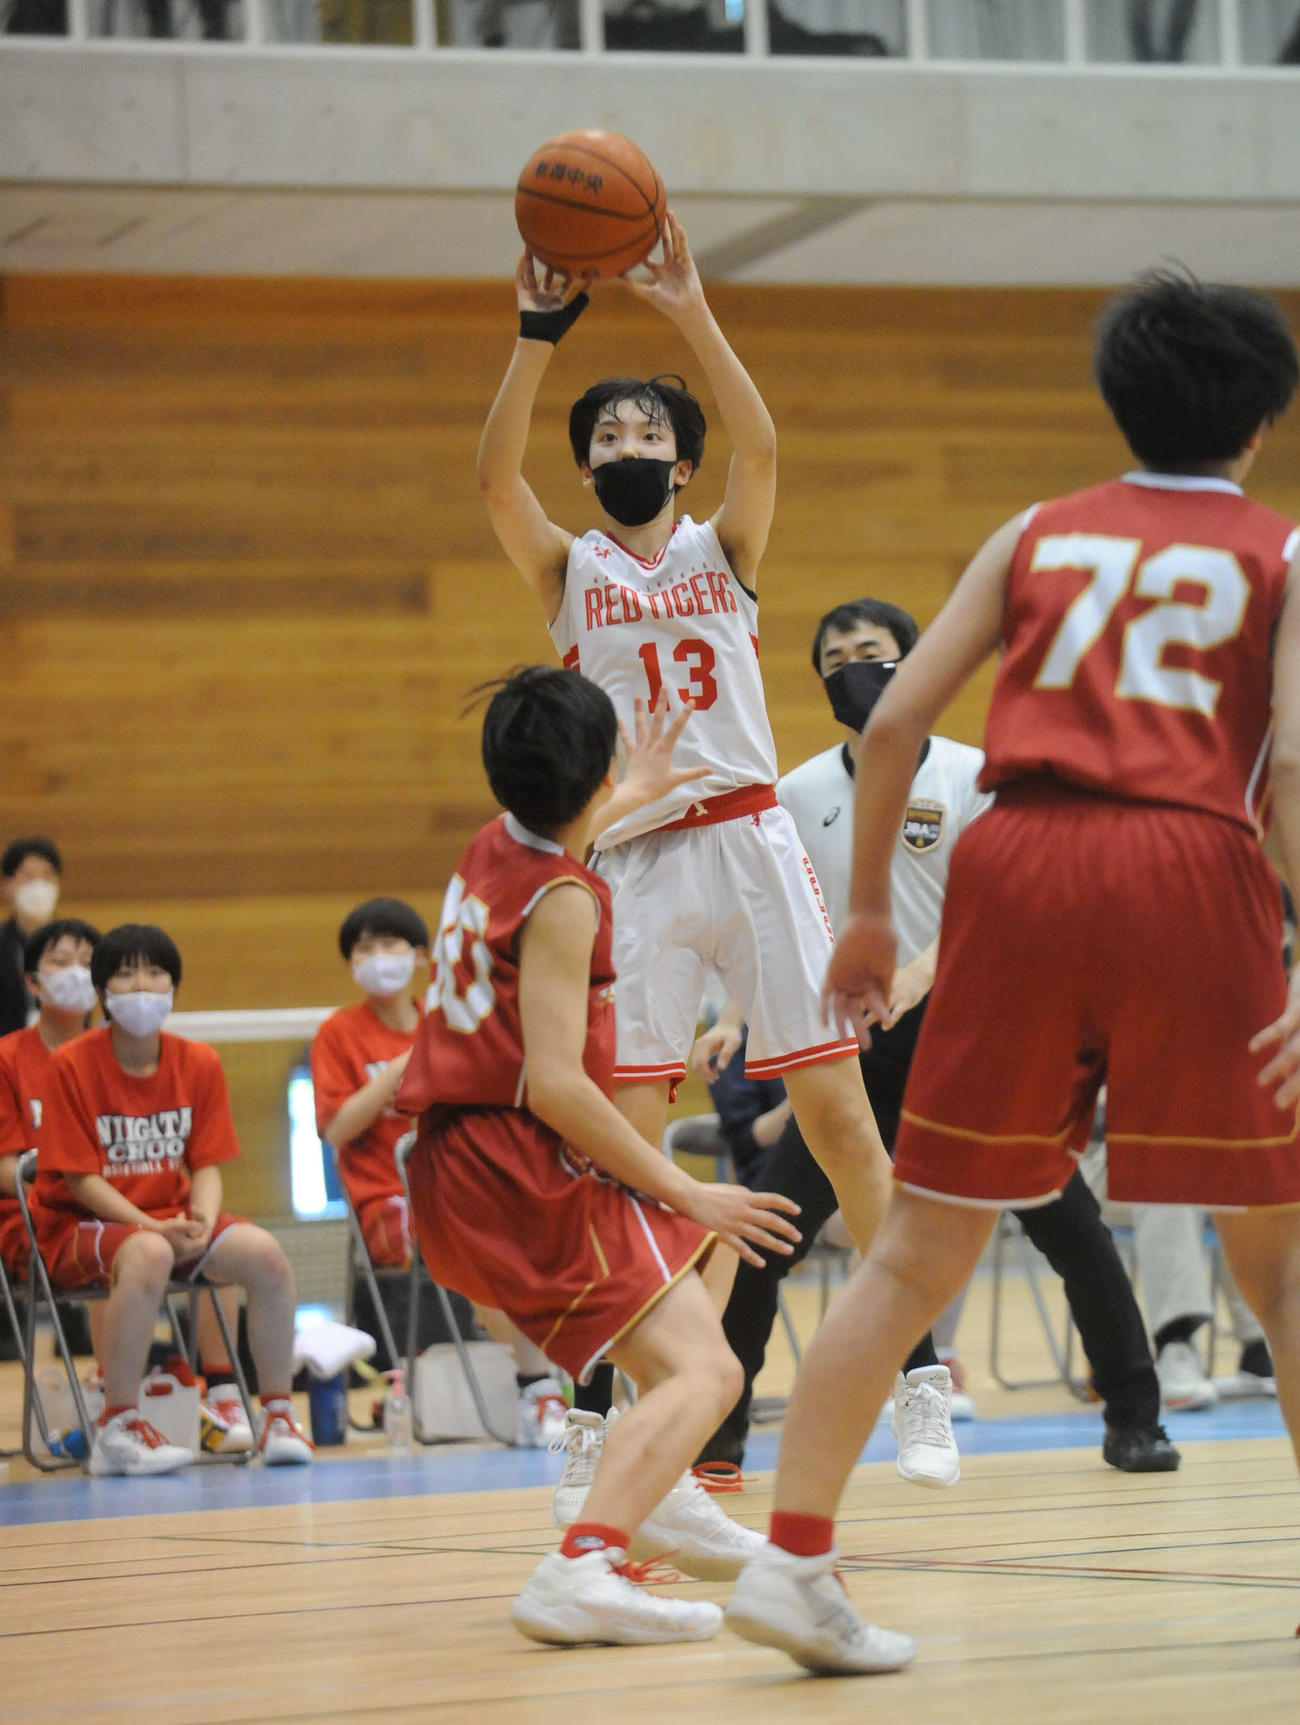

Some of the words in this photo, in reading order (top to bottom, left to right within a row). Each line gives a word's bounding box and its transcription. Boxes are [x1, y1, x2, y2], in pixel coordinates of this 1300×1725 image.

[584, 583, 643, 631] RED
[1030, 532, 1251, 720] 72
[638, 638, 718, 714] 13
